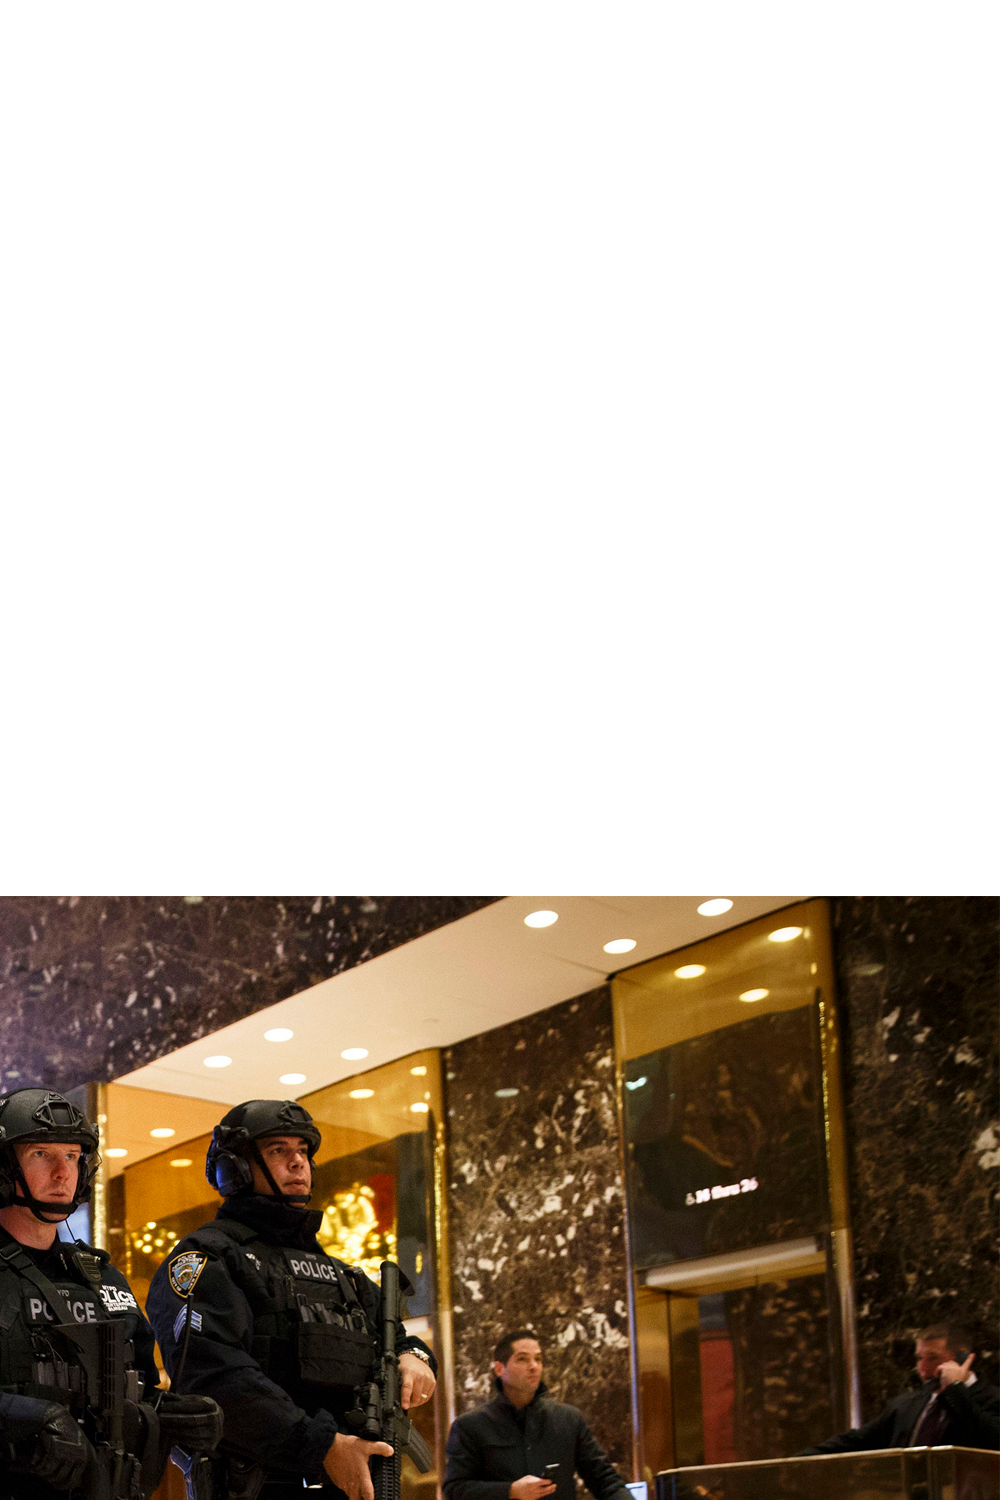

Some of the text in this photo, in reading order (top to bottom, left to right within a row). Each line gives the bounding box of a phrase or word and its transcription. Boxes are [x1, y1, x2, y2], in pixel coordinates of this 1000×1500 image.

[290, 1259, 337, 1281] POLICE
[99, 1289, 137, 1306] OLICE
[29, 1298, 97, 1323] POICE
